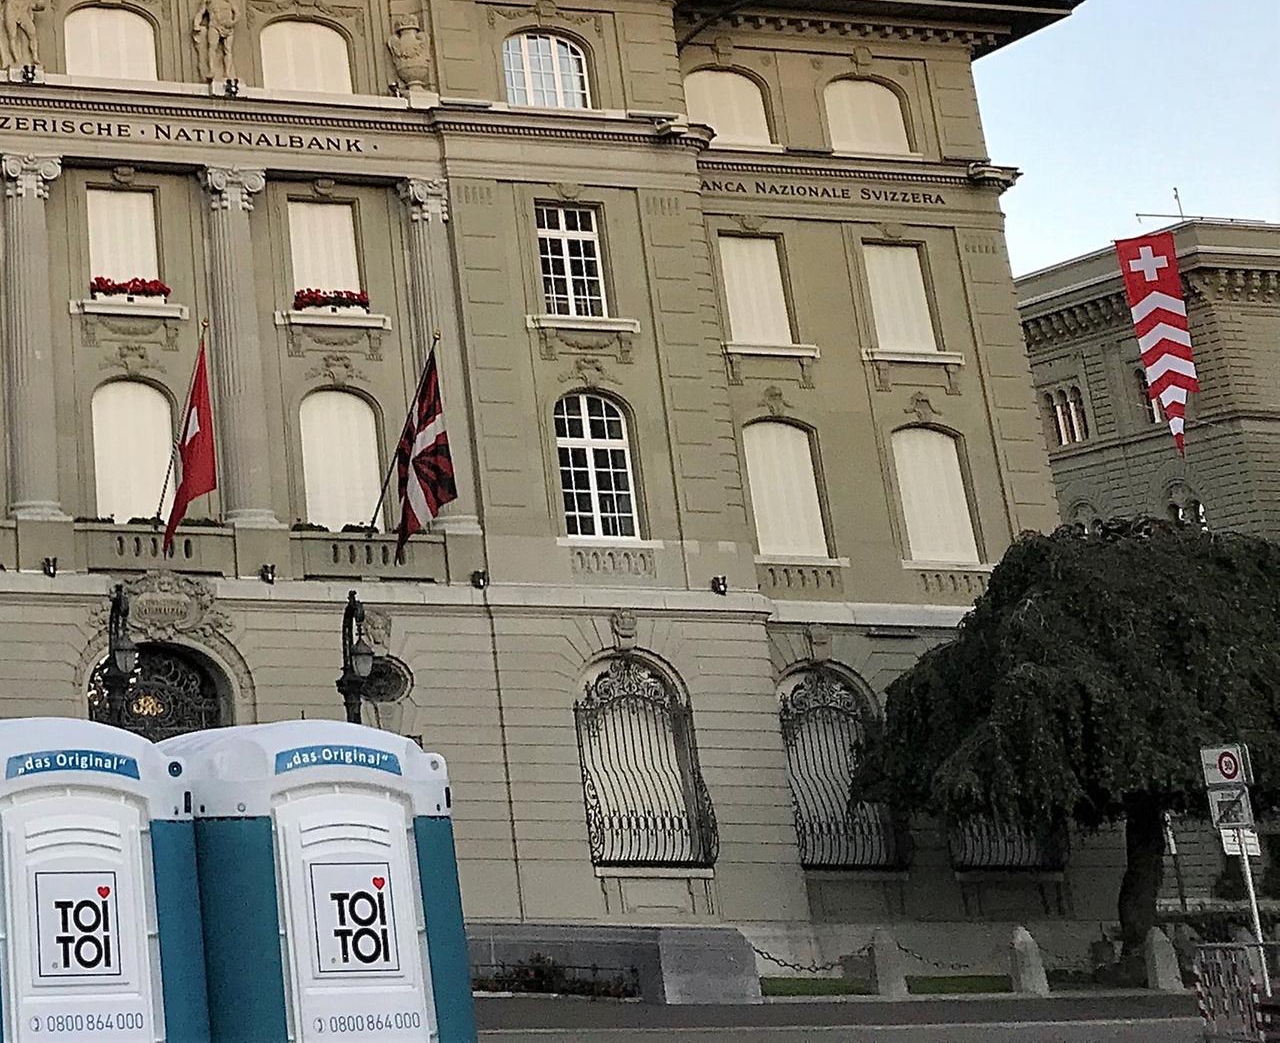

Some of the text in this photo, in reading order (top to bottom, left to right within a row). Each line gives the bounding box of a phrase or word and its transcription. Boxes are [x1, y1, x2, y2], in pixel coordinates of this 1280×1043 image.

[155, 124, 364, 153] NATIONALBANK
[700, 180, 945, 205] ANCA NAZIONALE SVIZZERA
[54, 900, 110, 933] TOI
[330, 891, 387, 927] TOI
[56, 935, 112, 968] TOI
[333, 928, 390, 964] TOI
